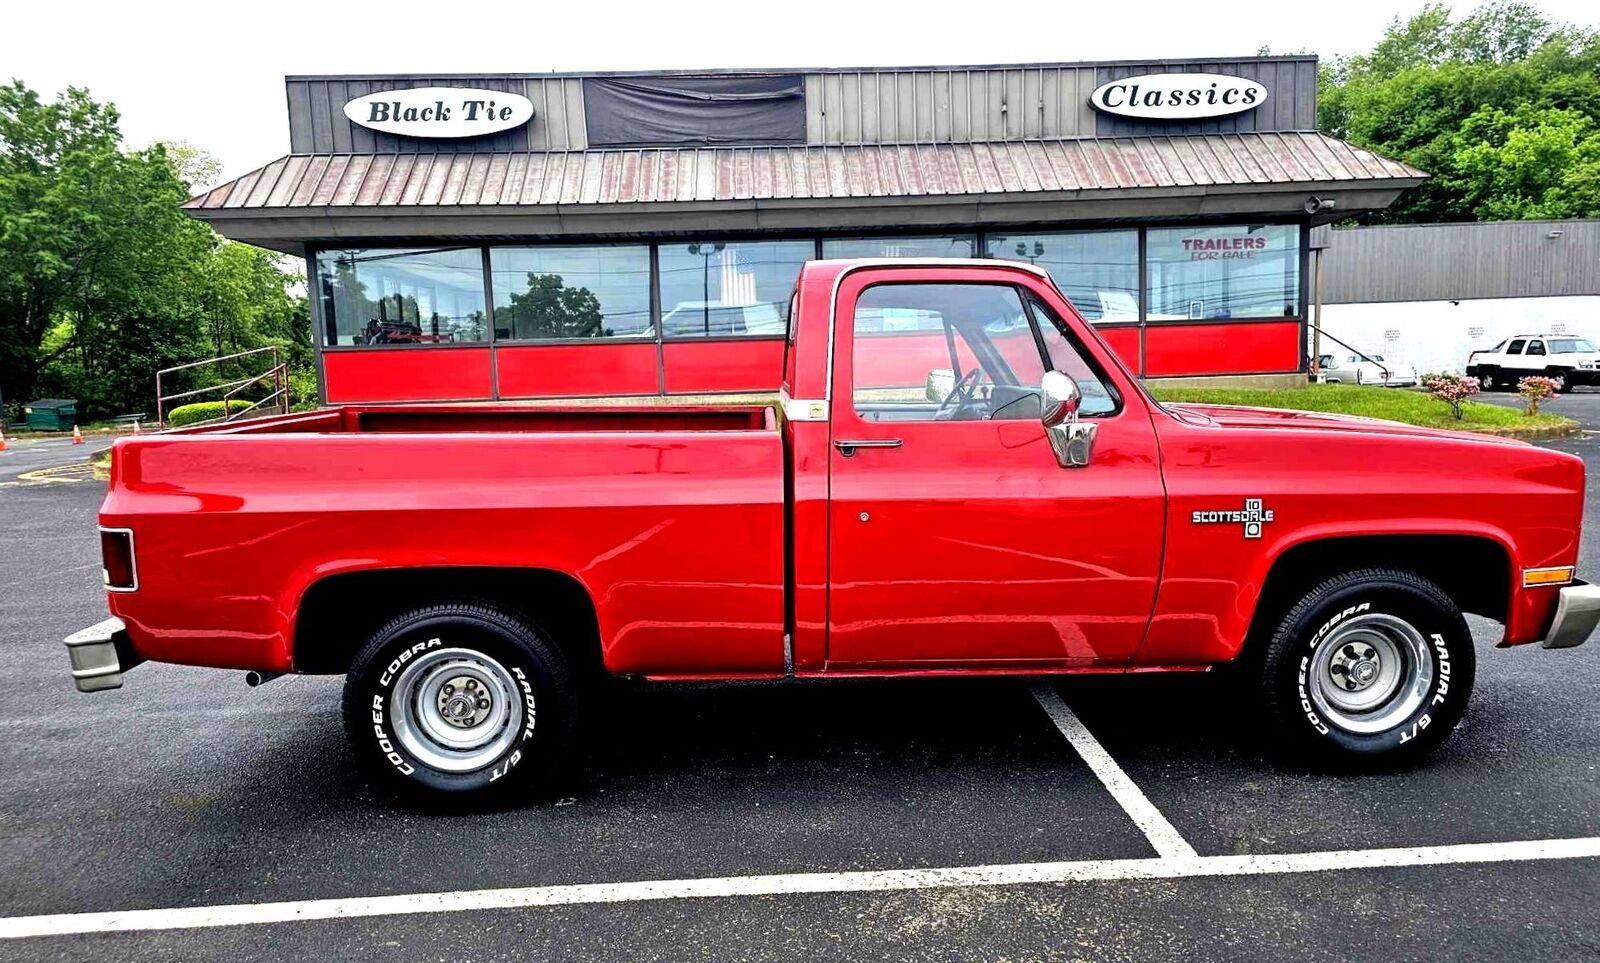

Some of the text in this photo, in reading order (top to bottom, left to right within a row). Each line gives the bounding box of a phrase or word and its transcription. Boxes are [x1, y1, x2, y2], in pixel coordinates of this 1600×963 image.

[1101, 83, 1258, 108] Classics
[366, 100, 513, 123] Black Tie
[1182, 237, 1266, 250] TRAILERS
[1191, 251, 1219, 261] FOR
[1192, 510, 1274, 523] SCOTTSDALE
[1248, 501, 1260, 510] 10
[1299, 602, 1371, 735] COOPER COBRA
[1399, 633, 1451, 744] RADIAL G/T
[372, 637, 442, 776] COOPER COBRA
[489, 667, 536, 782] RADIAL G/T
